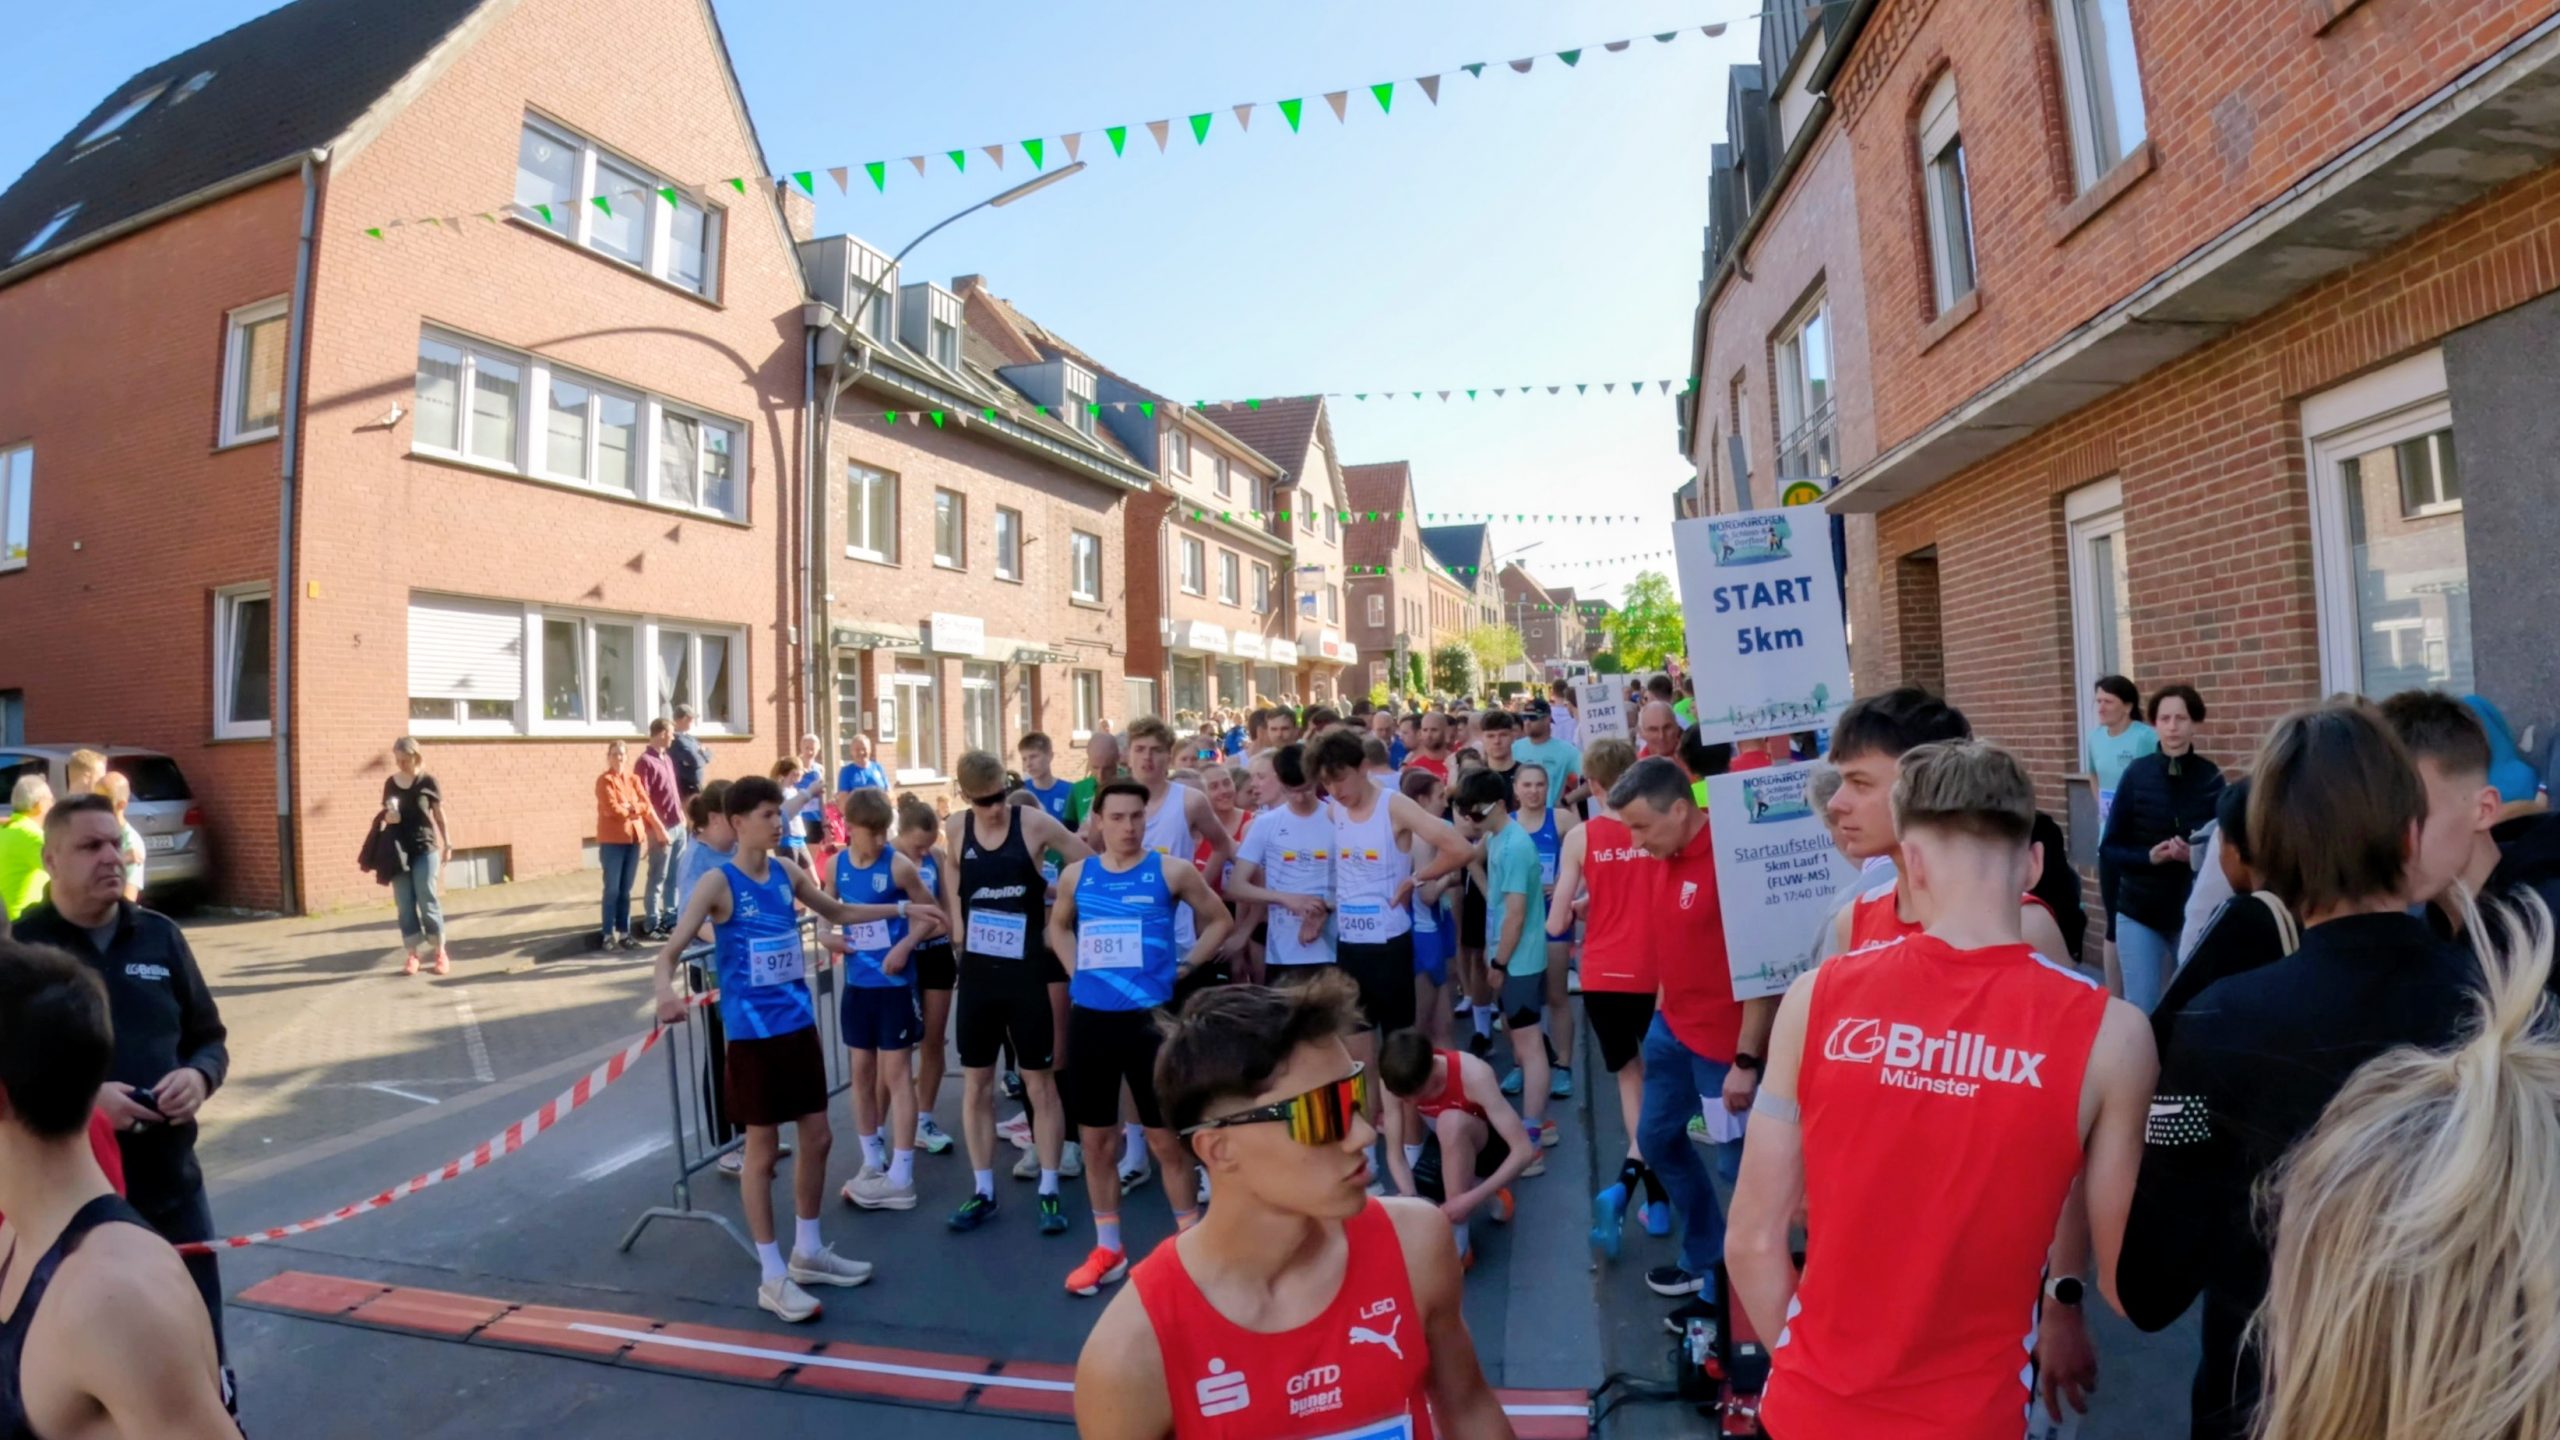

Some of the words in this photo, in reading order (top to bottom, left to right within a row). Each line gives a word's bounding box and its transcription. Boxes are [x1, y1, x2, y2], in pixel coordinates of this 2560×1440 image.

[1708, 514, 1786, 532] NORDKIRCHEN
[1713, 576, 1812, 613] START
[1737, 627, 1804, 655] 5km
[1587, 705, 1616, 719] START
[1591, 848, 1613, 863] TuS
[1735, 833, 1836, 862] Startaufstellu
[1765, 860, 1791, 873] 5km
[1794, 854, 1819, 868] Lauf
[1822, 853, 1829, 863] 1
[1767, 869, 1830, 890] (FLVW-MS)
[1765, 892, 1781, 905] ab
[1784, 888, 1812, 901] 17:40
[1815, 884, 1837, 896] Uhr
[1345, 917, 1376, 931] 2406
[979, 927, 1015, 945] 1612
[1094, 937, 1124, 954] 881
[767, 951, 793, 970] 972
[1884, 1023, 2046, 1089] Brillux
[1880, 1067, 1980, 1099] Münster
[1360, 1297, 1396, 1320] LGO
[1286, 1364, 1341, 1395] GfTD
[1289, 1386, 1342, 1416] bunert
